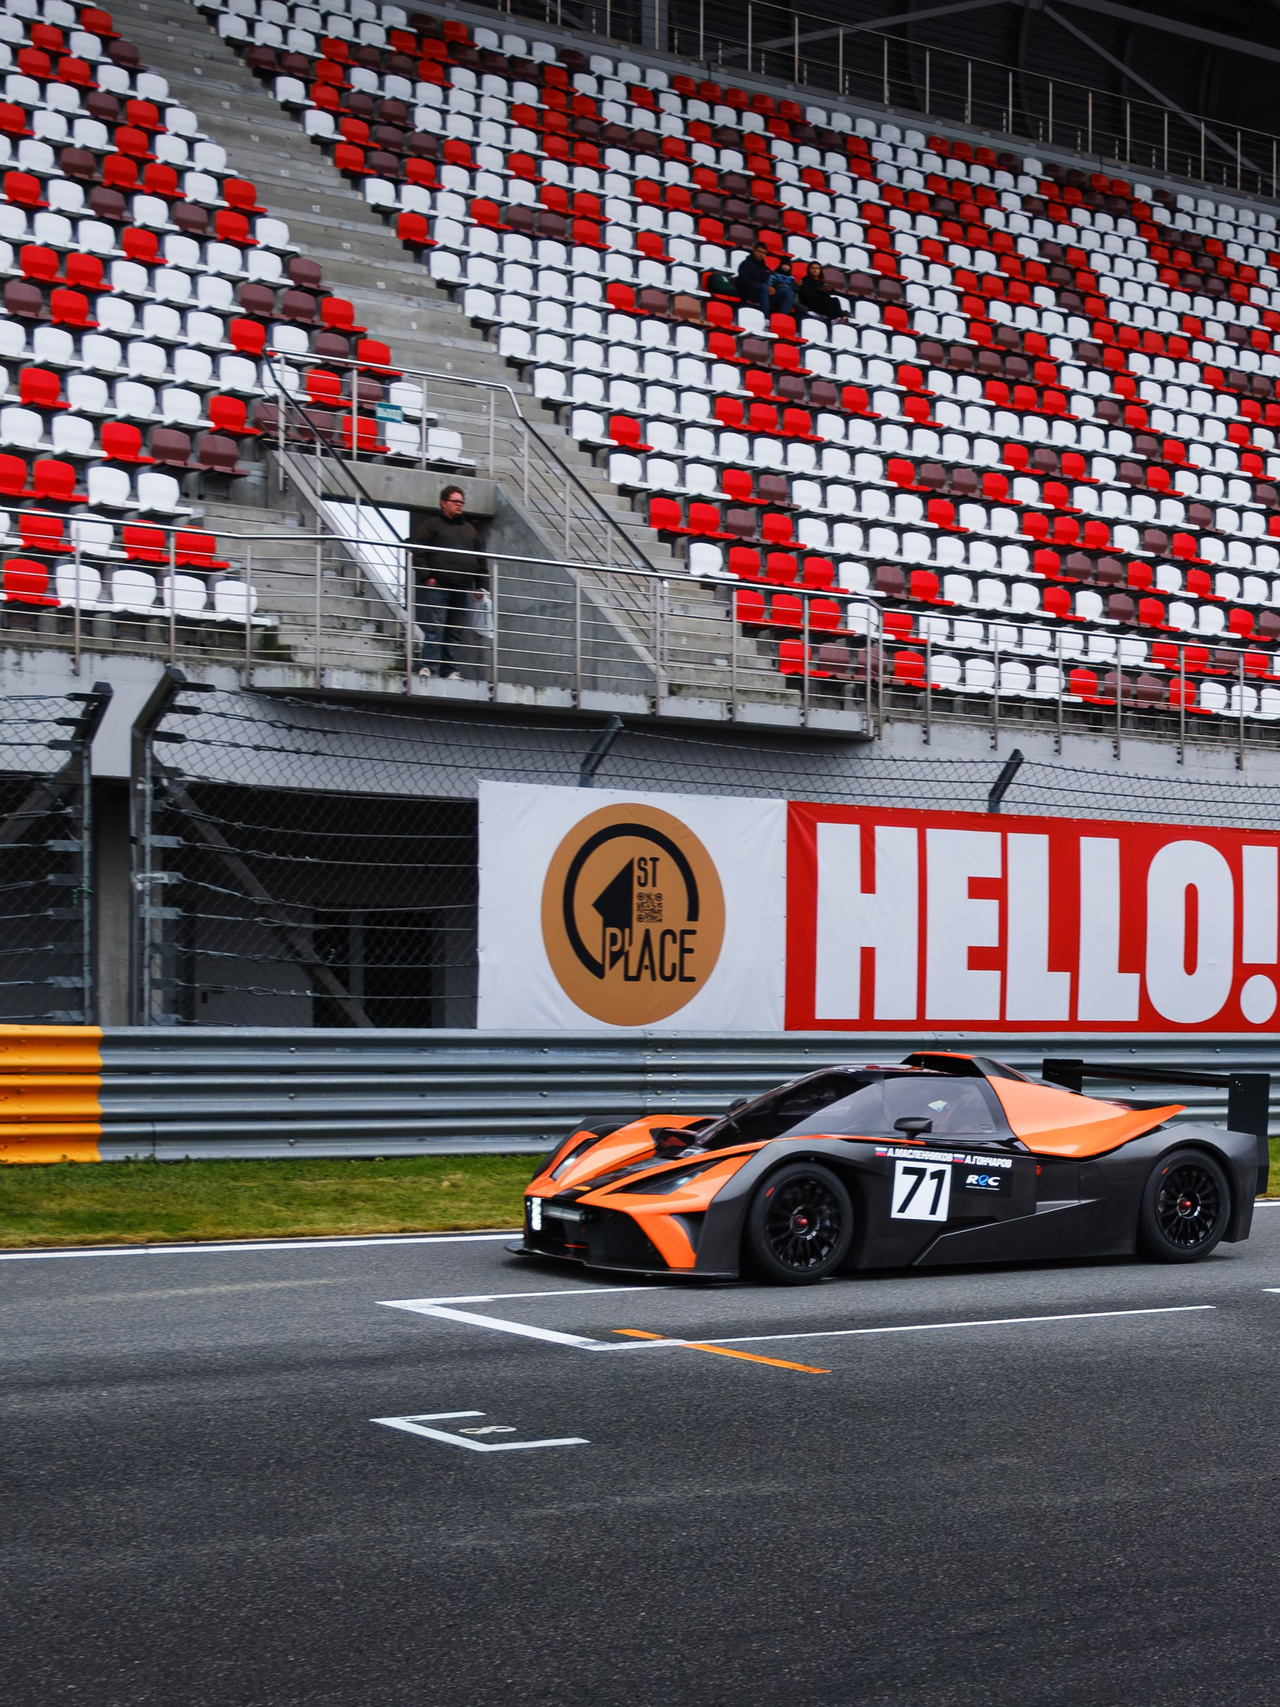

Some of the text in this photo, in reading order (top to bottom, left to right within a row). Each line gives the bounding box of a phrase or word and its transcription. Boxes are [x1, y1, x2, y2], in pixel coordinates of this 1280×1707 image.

[815, 822, 1278, 1025] HELLO!
[603, 926, 698, 982] PLACE
[896, 1166, 947, 1216] 71
